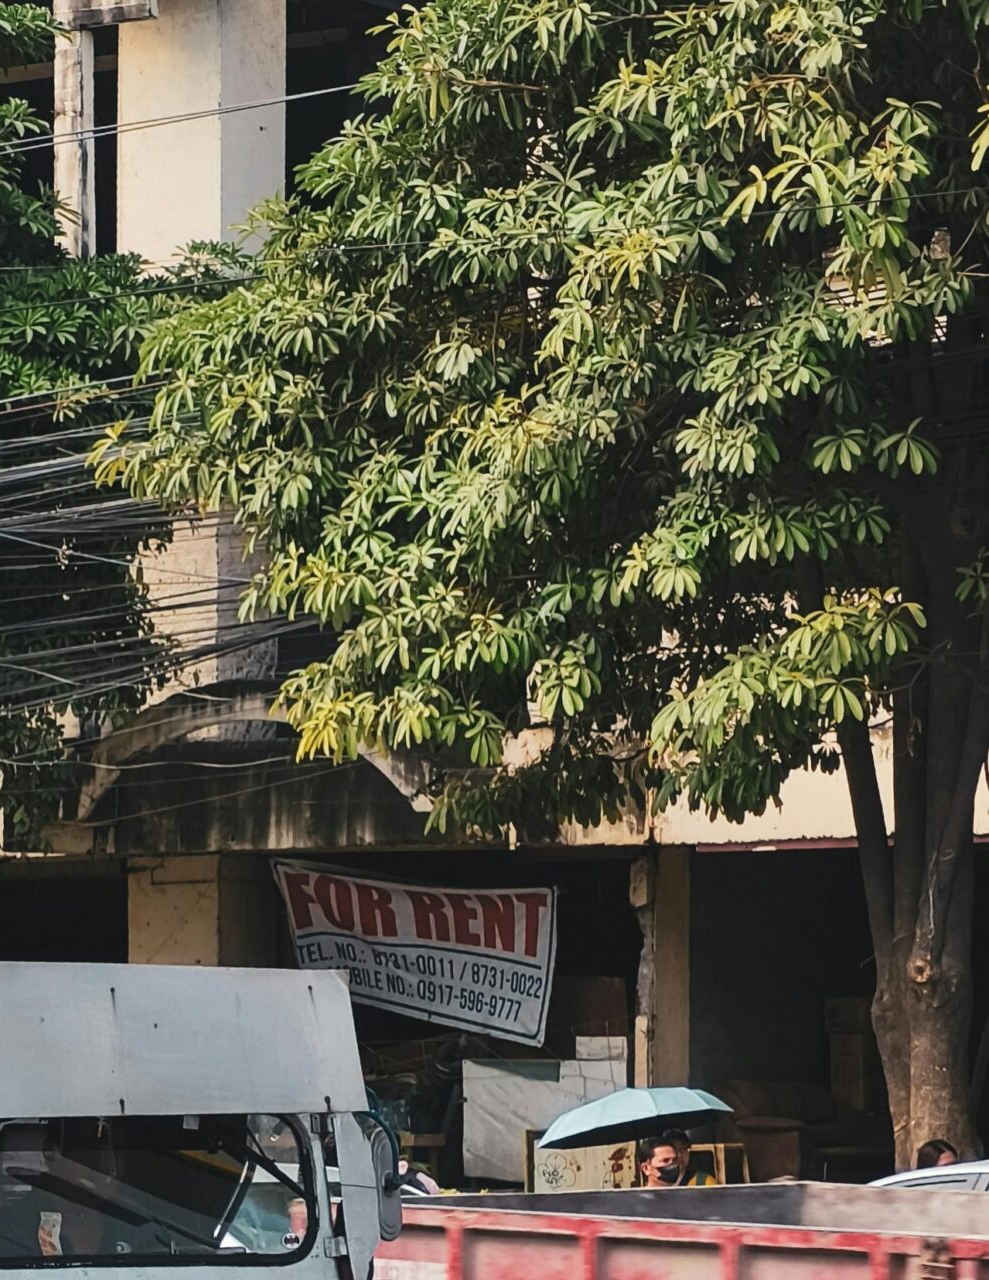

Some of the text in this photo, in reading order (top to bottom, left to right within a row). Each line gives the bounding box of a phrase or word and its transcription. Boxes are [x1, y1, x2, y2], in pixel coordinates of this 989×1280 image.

[284, 871, 548, 958] FOR RENT
[298, 942, 334, 964] TEL.
[335, 942, 367, 964] NO.:
[471, 963, 542, 999] 8731-0022
[386, 973, 415, 998] NO.:
[417, 979, 522, 1022] 0917-596-9777
